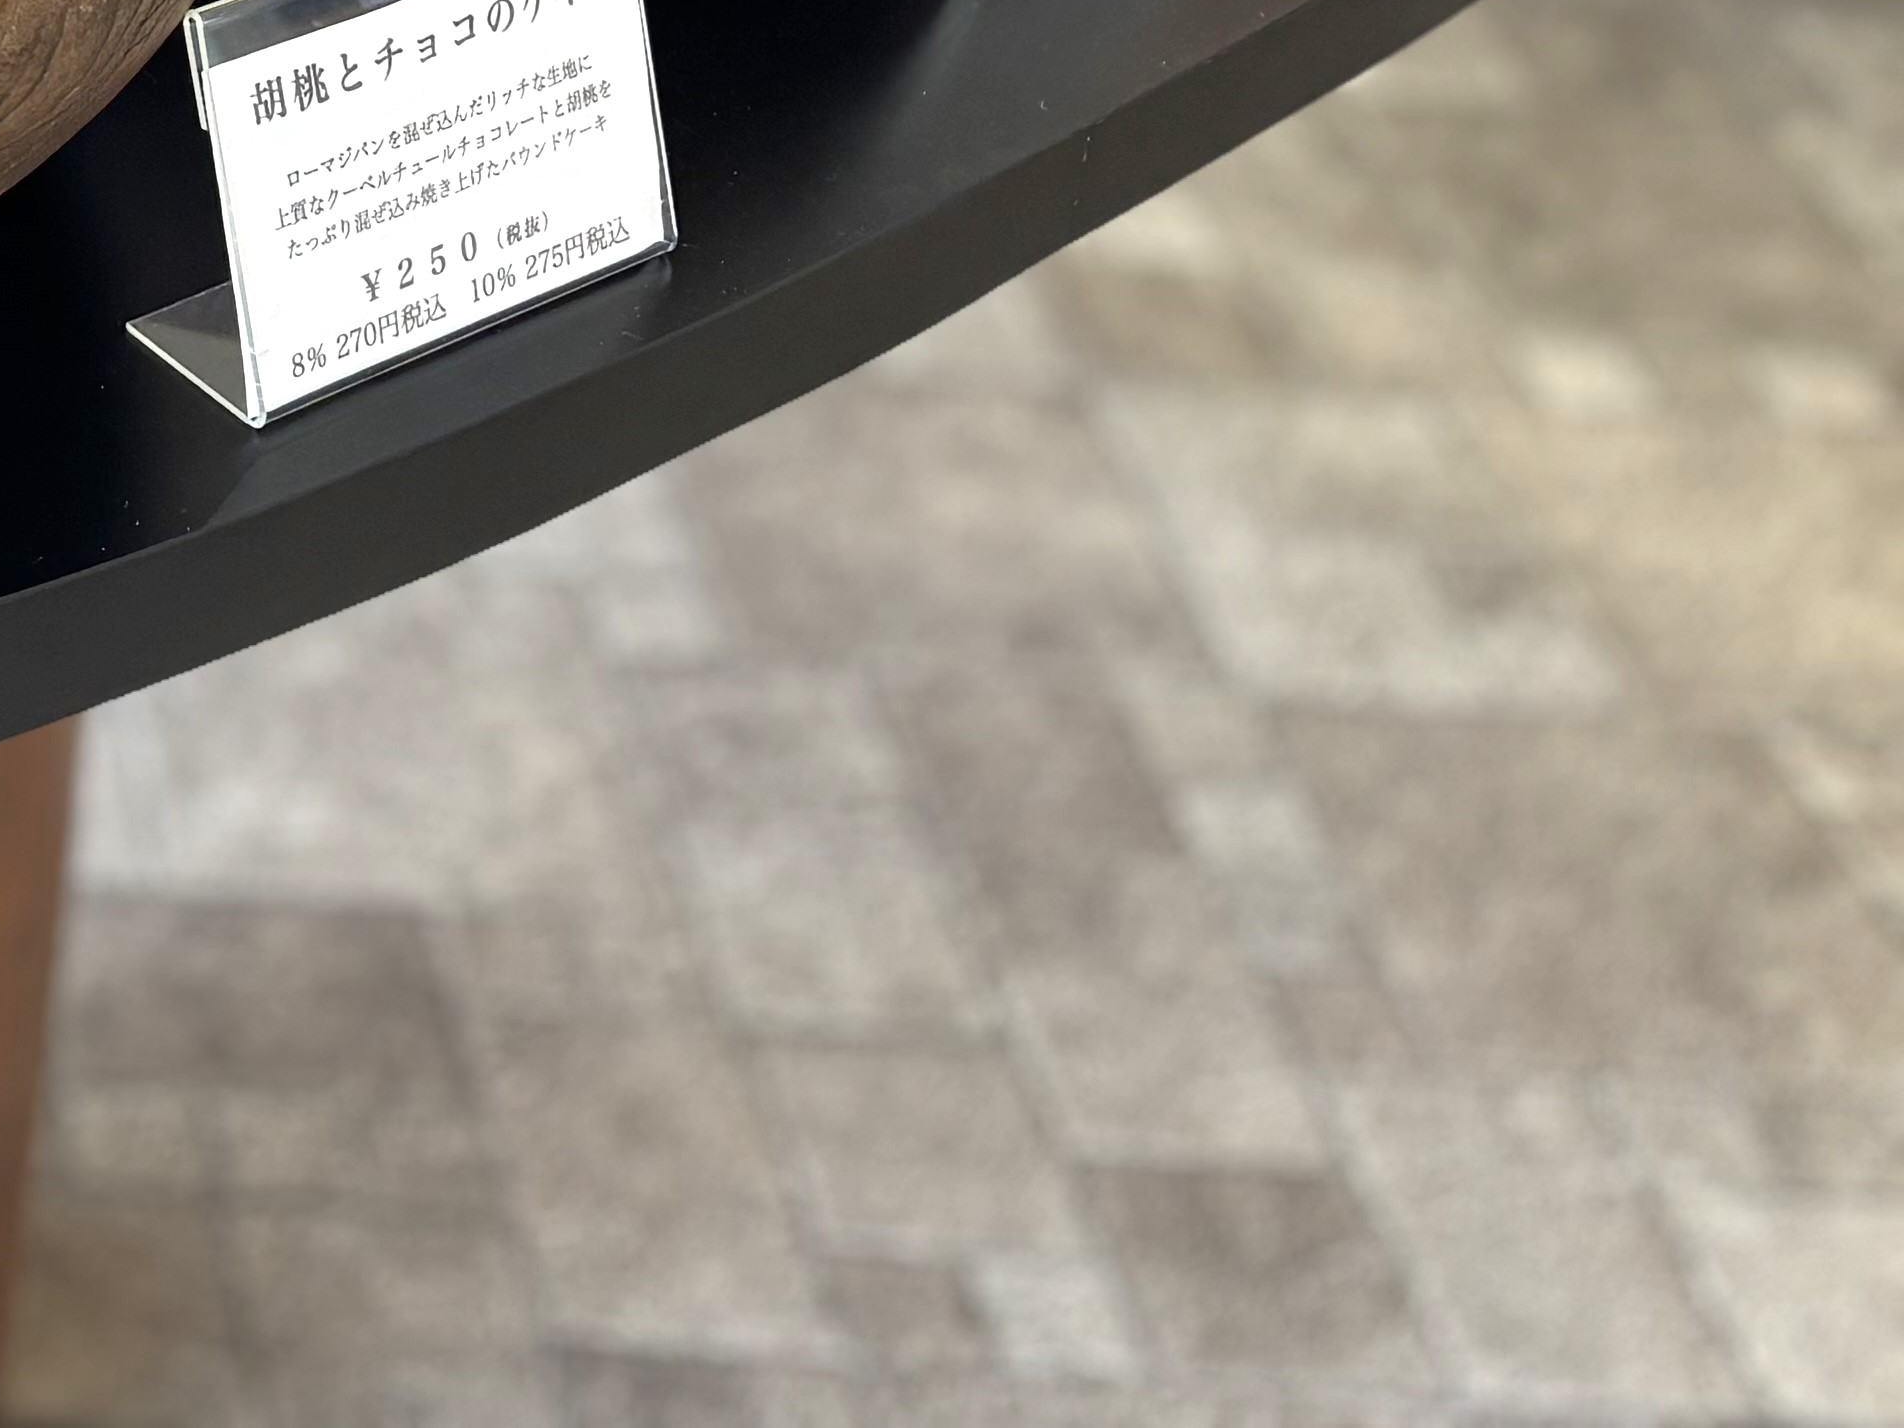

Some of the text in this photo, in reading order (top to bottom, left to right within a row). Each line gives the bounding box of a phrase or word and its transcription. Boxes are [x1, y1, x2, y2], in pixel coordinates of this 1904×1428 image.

[275, 79, 610, 230] 上質なクーベルチュールチョコレートと胡桃を
[287, 55, 592, 187] ローマジパンを混ぜ込んだリッチな生地に
[287, 114, 606, 259] たっぷり混ぜ込み焼き上げたパウンドケーキ
[291, 215, 630, 377] 8% 270円税込 10% 275円税込
[360, 231, 477, 302] ¥250
